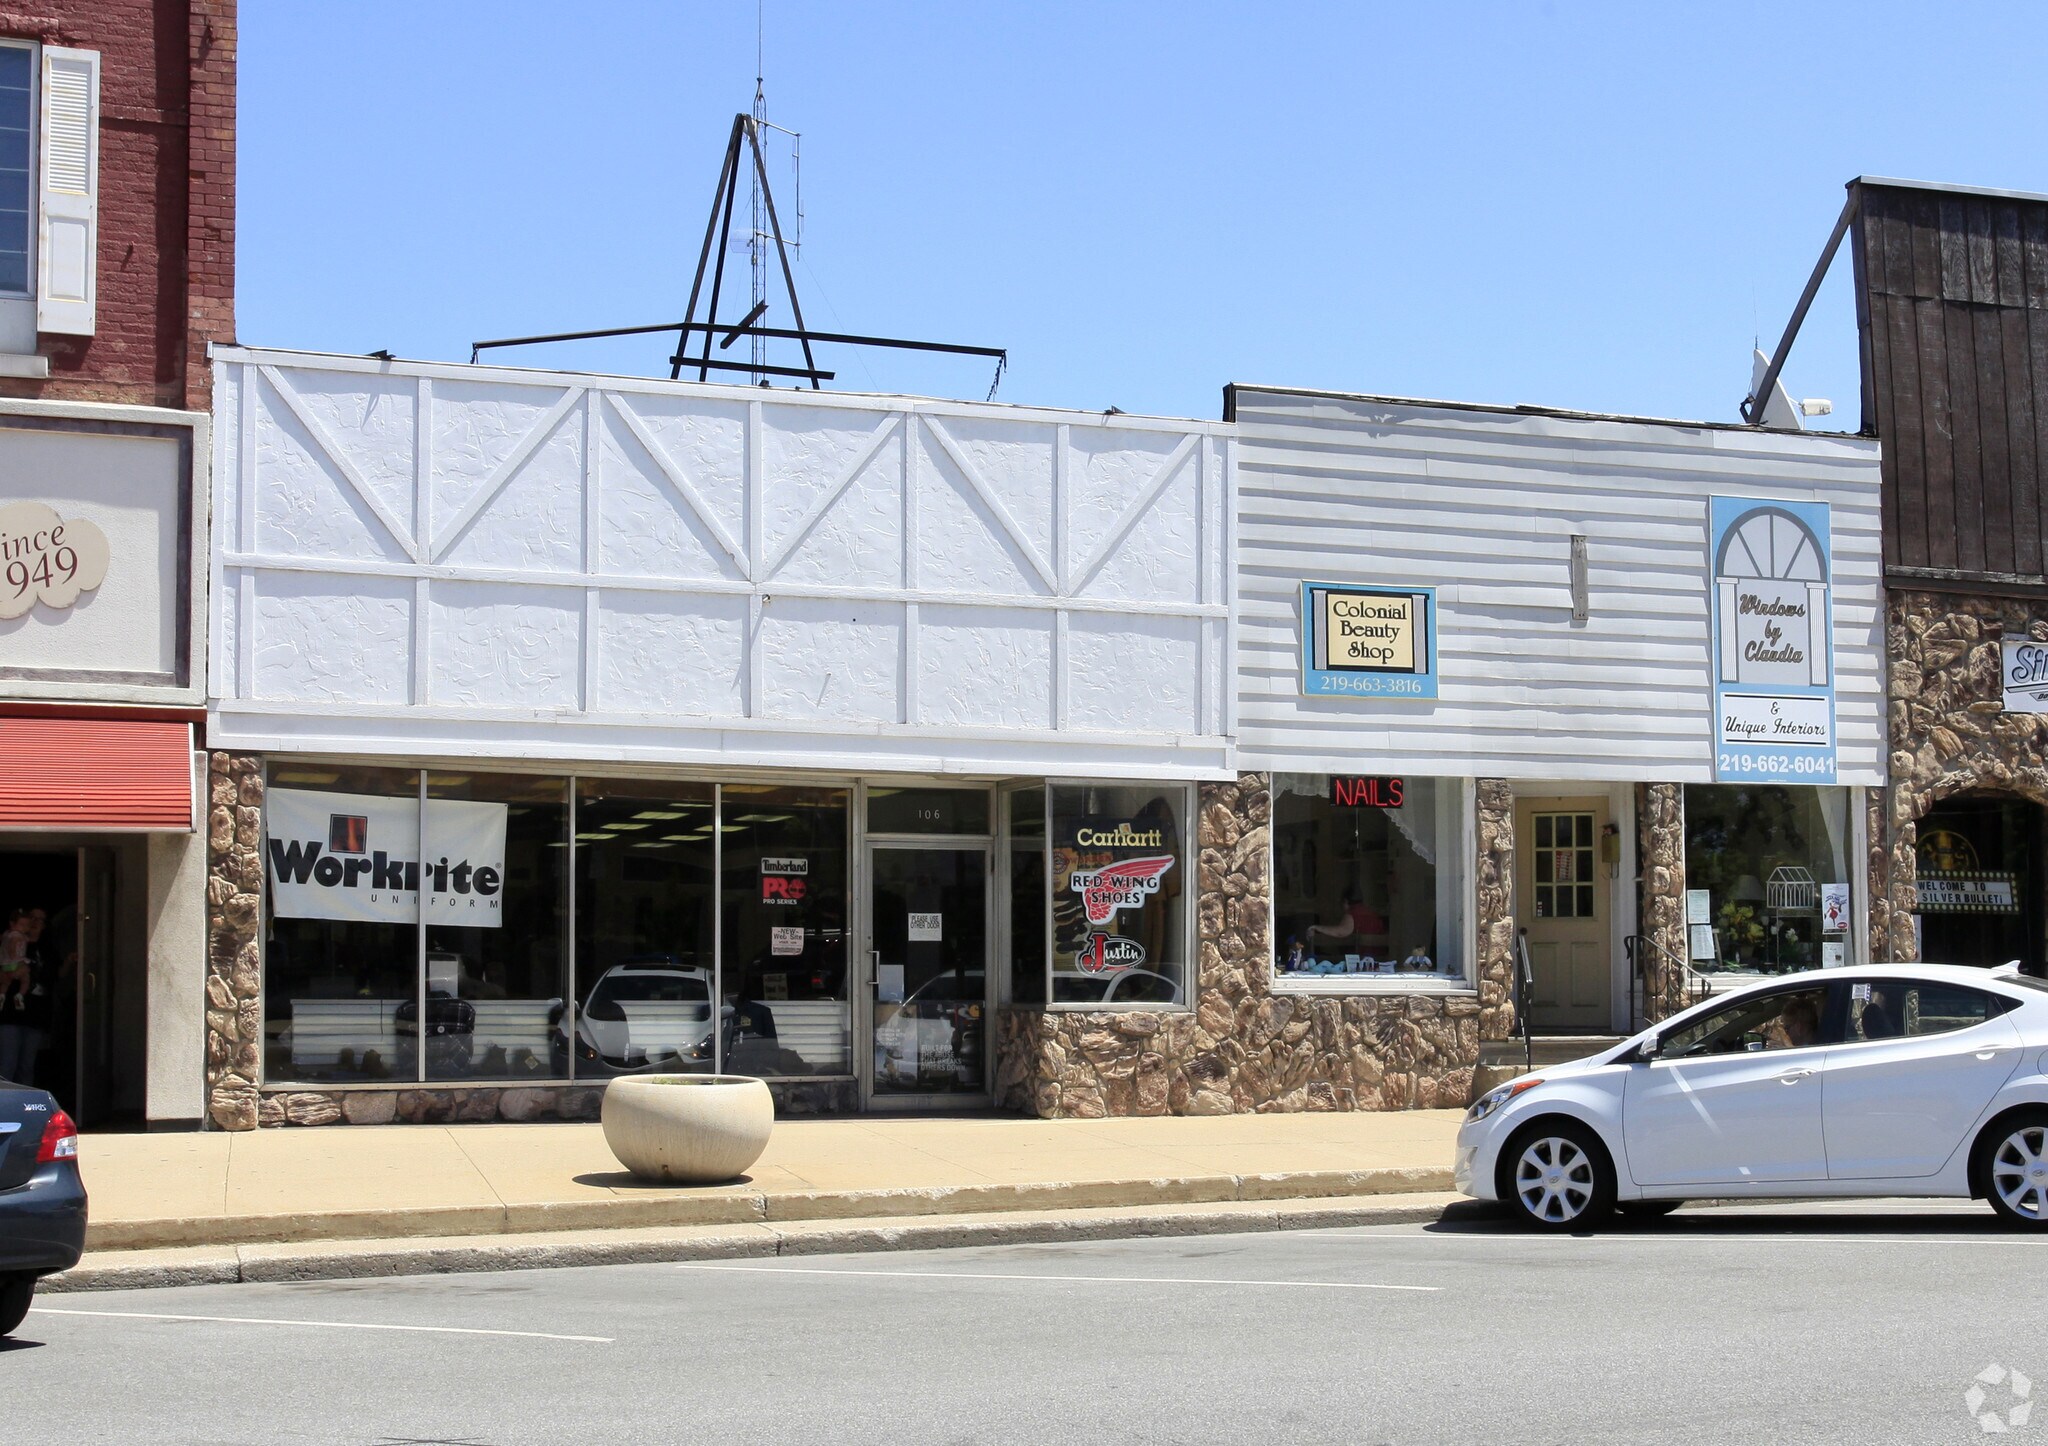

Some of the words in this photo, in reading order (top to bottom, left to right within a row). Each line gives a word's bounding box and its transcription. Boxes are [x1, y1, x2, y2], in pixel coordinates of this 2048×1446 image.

[1, 525, 66, 561] ince
[6, 546, 78, 599] 949
[1333, 600, 1407, 620] Colonial
[1739, 593, 1806, 617] Windows
[1340, 620, 1401, 644] Beauty
[1764, 619, 1783, 647] by
[1347, 641, 1395, 665] Shop
[1744, 640, 1804, 664] Claudia
[1321, 676, 1422, 693] 219-663-3816
[1770, 701, 1781, 716] &
[1725, 716, 1768, 739] Unique
[1772, 718, 1827, 736] Interiors
[1720, 753, 1836, 775] 219-662-6041
[1335, 778, 1404, 806] NAILS
[917, 809, 941, 820] 106
[1077, 827, 1163, 848] Carhartt
[268, 837, 500, 897] Workrite
[762, 859, 808, 873] Timberland
[1072, 875, 1104, 888] RED
[1110, 876, 1159, 889] WING
[1918, 882, 1966, 892] WELCOME
[1974, 883, 1987, 892] TO
[370, 893, 499, 910] UNIFORM
[1090, 891, 1142, 905] SHOES
[1922, 893, 1962, 903] SILVER
[1081, 933, 1142, 973] Justin
